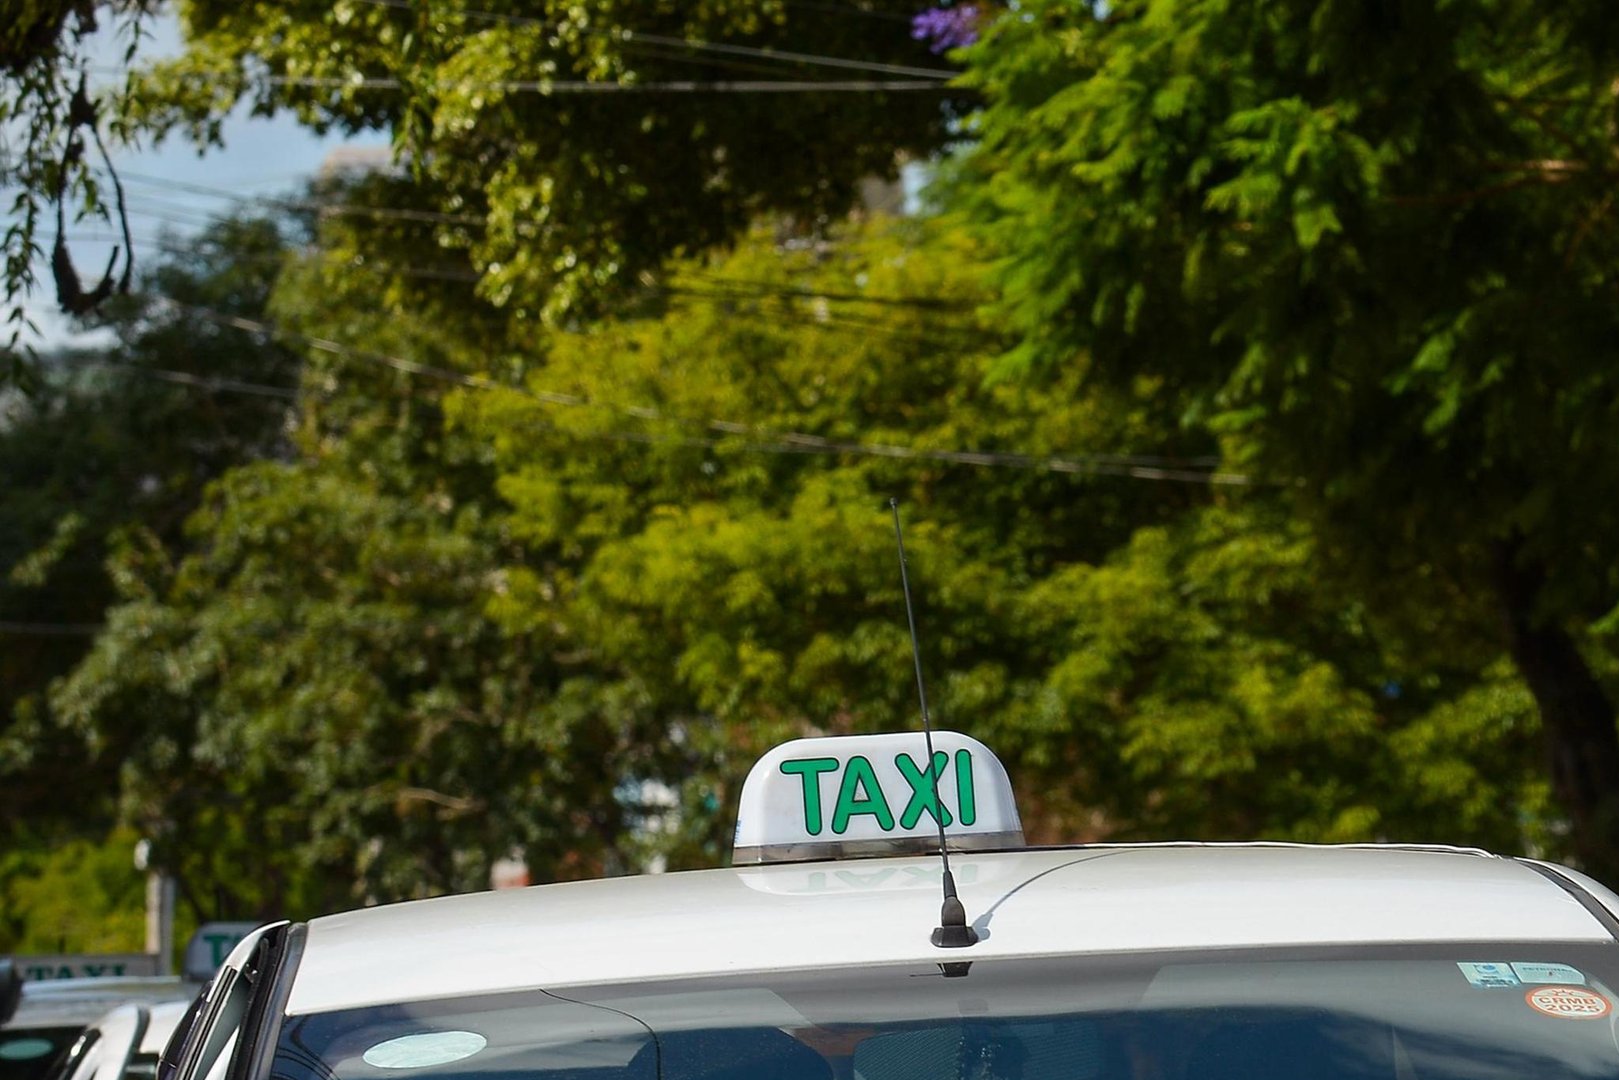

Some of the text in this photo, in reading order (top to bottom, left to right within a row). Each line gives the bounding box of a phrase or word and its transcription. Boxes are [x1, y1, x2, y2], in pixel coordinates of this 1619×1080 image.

[780, 748, 976, 836] TAXI
[1539, 997, 1597, 1005] CRMB
[1545, 1004, 1601, 1013] 2025
